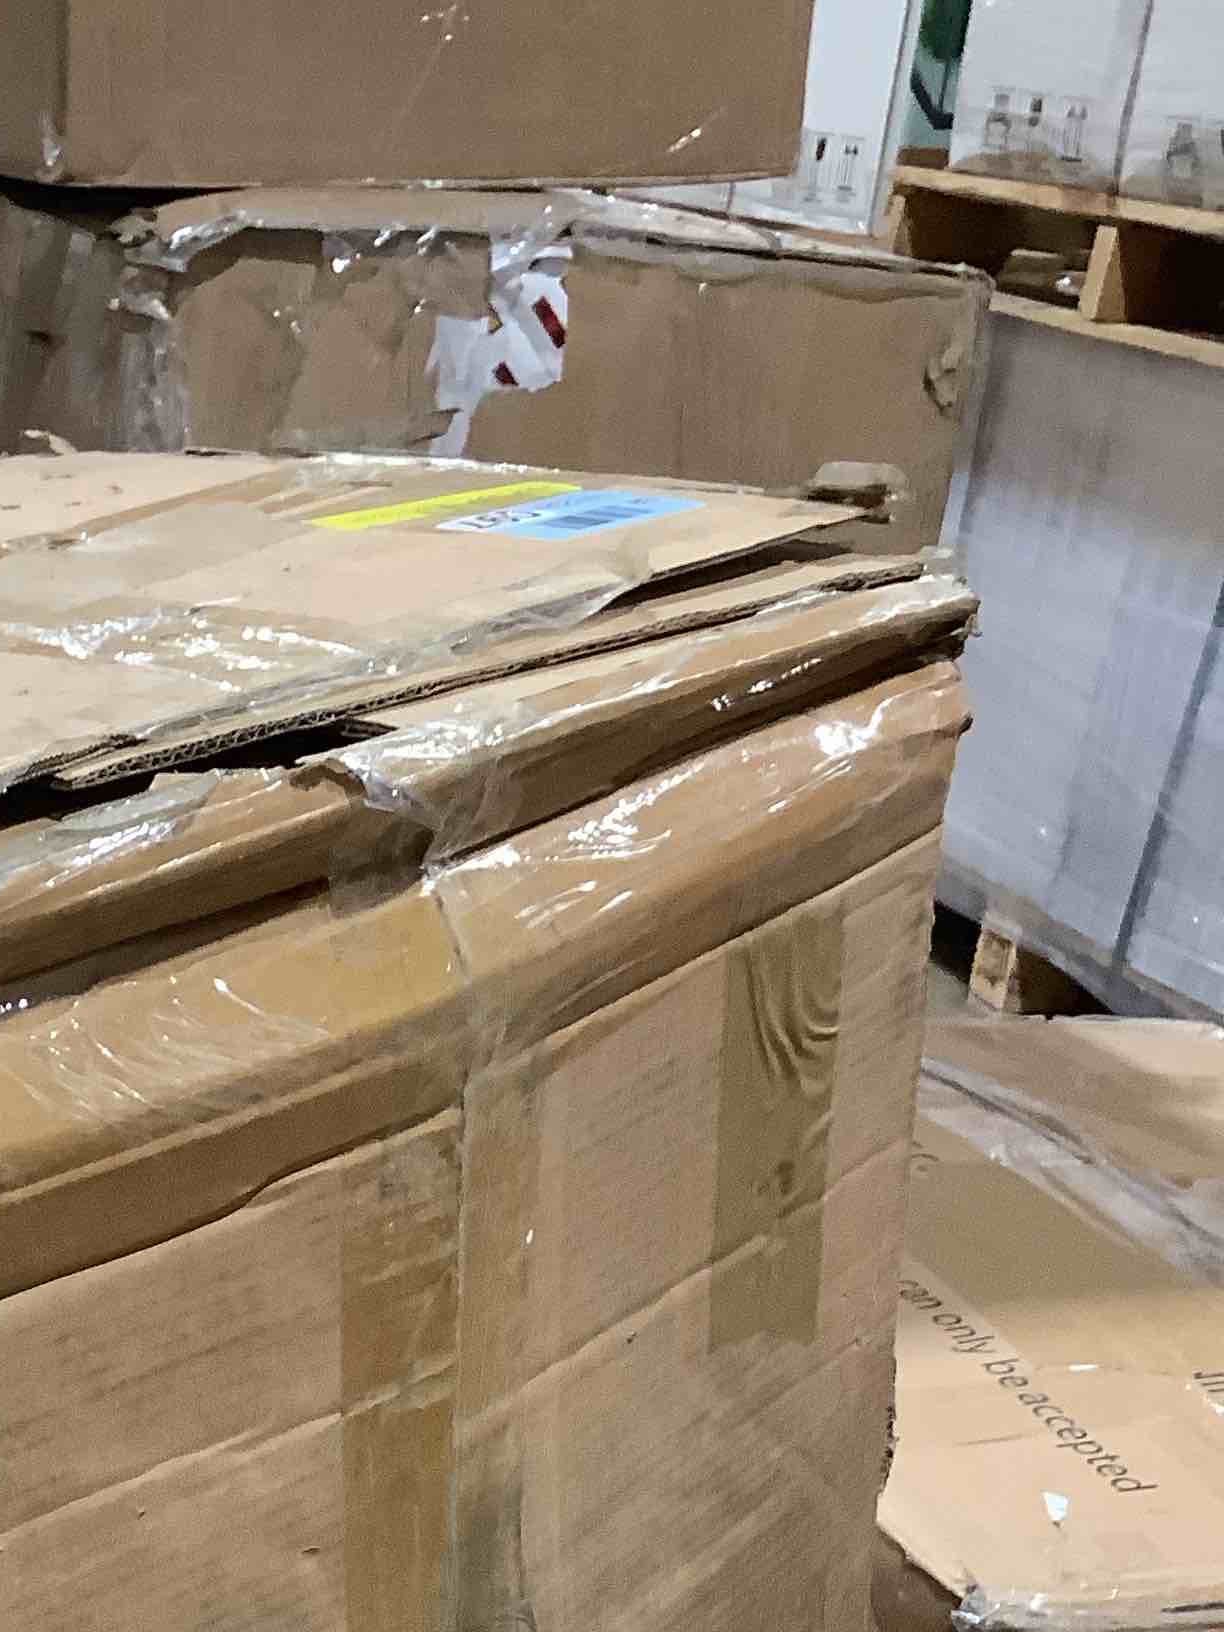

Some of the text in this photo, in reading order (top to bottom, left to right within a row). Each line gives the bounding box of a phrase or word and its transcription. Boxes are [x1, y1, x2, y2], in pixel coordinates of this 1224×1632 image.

[931, 1312, 997, 1354] only
[980, 1357, 1029, 1390] be
[1017, 1392, 1160, 1494] accepted
